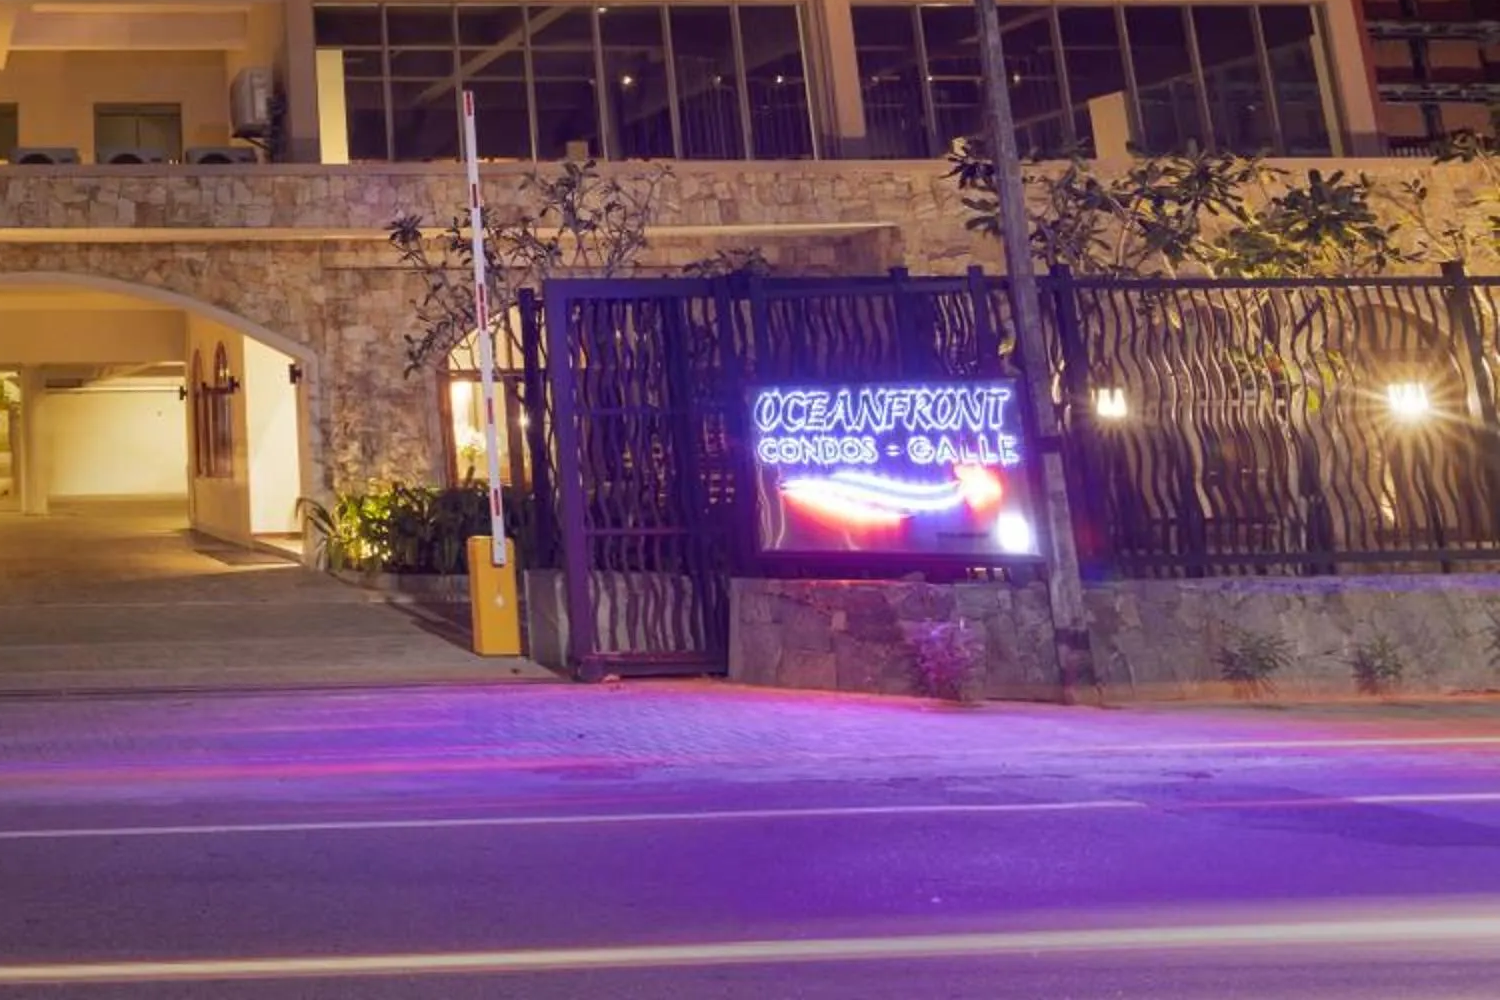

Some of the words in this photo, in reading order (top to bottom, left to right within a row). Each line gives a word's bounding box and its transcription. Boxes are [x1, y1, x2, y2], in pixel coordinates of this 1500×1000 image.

[754, 387, 1011, 431] OCEANFRONT
[757, 437, 878, 464] CONDOS
[907, 434, 1021, 465] GALLE
